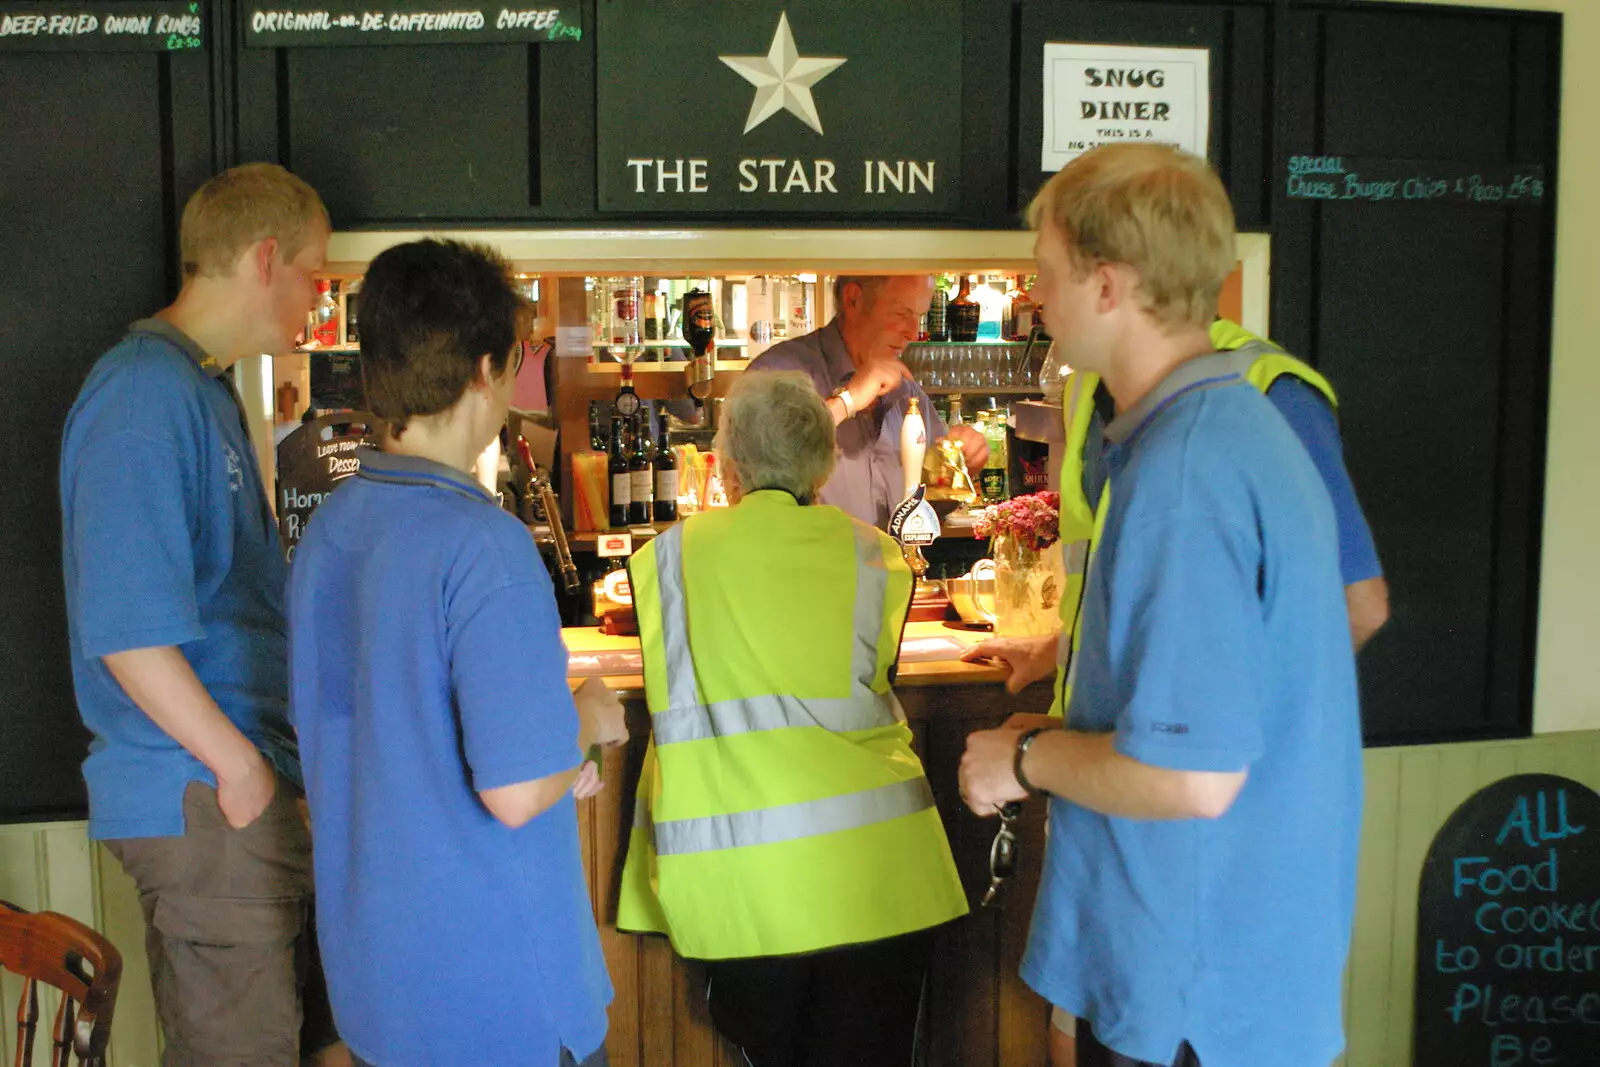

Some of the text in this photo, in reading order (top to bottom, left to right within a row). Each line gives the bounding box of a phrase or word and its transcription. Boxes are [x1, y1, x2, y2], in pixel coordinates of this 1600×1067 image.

[0, 14, 200, 36] DEEP-FRIED ONION RINGS
[497, 9, 559, 30] COFFEE
[1084, 67, 1165, 88] SNUG
[1080, 100, 1170, 121] DINER
[1096, 128, 1153, 137] THIS IS A
[1068, 140, 1085, 150] NO
[627, 159, 936, 194] THE STAR INN
[317, 444, 338, 458] Leave
[329, 456, 361, 474] Desser
[891, 498, 918, 534] ADNAMS
[1453, 847, 1558, 899] Food
[1436, 937, 1600, 973] to order
[1446, 983, 1600, 1026] Please
